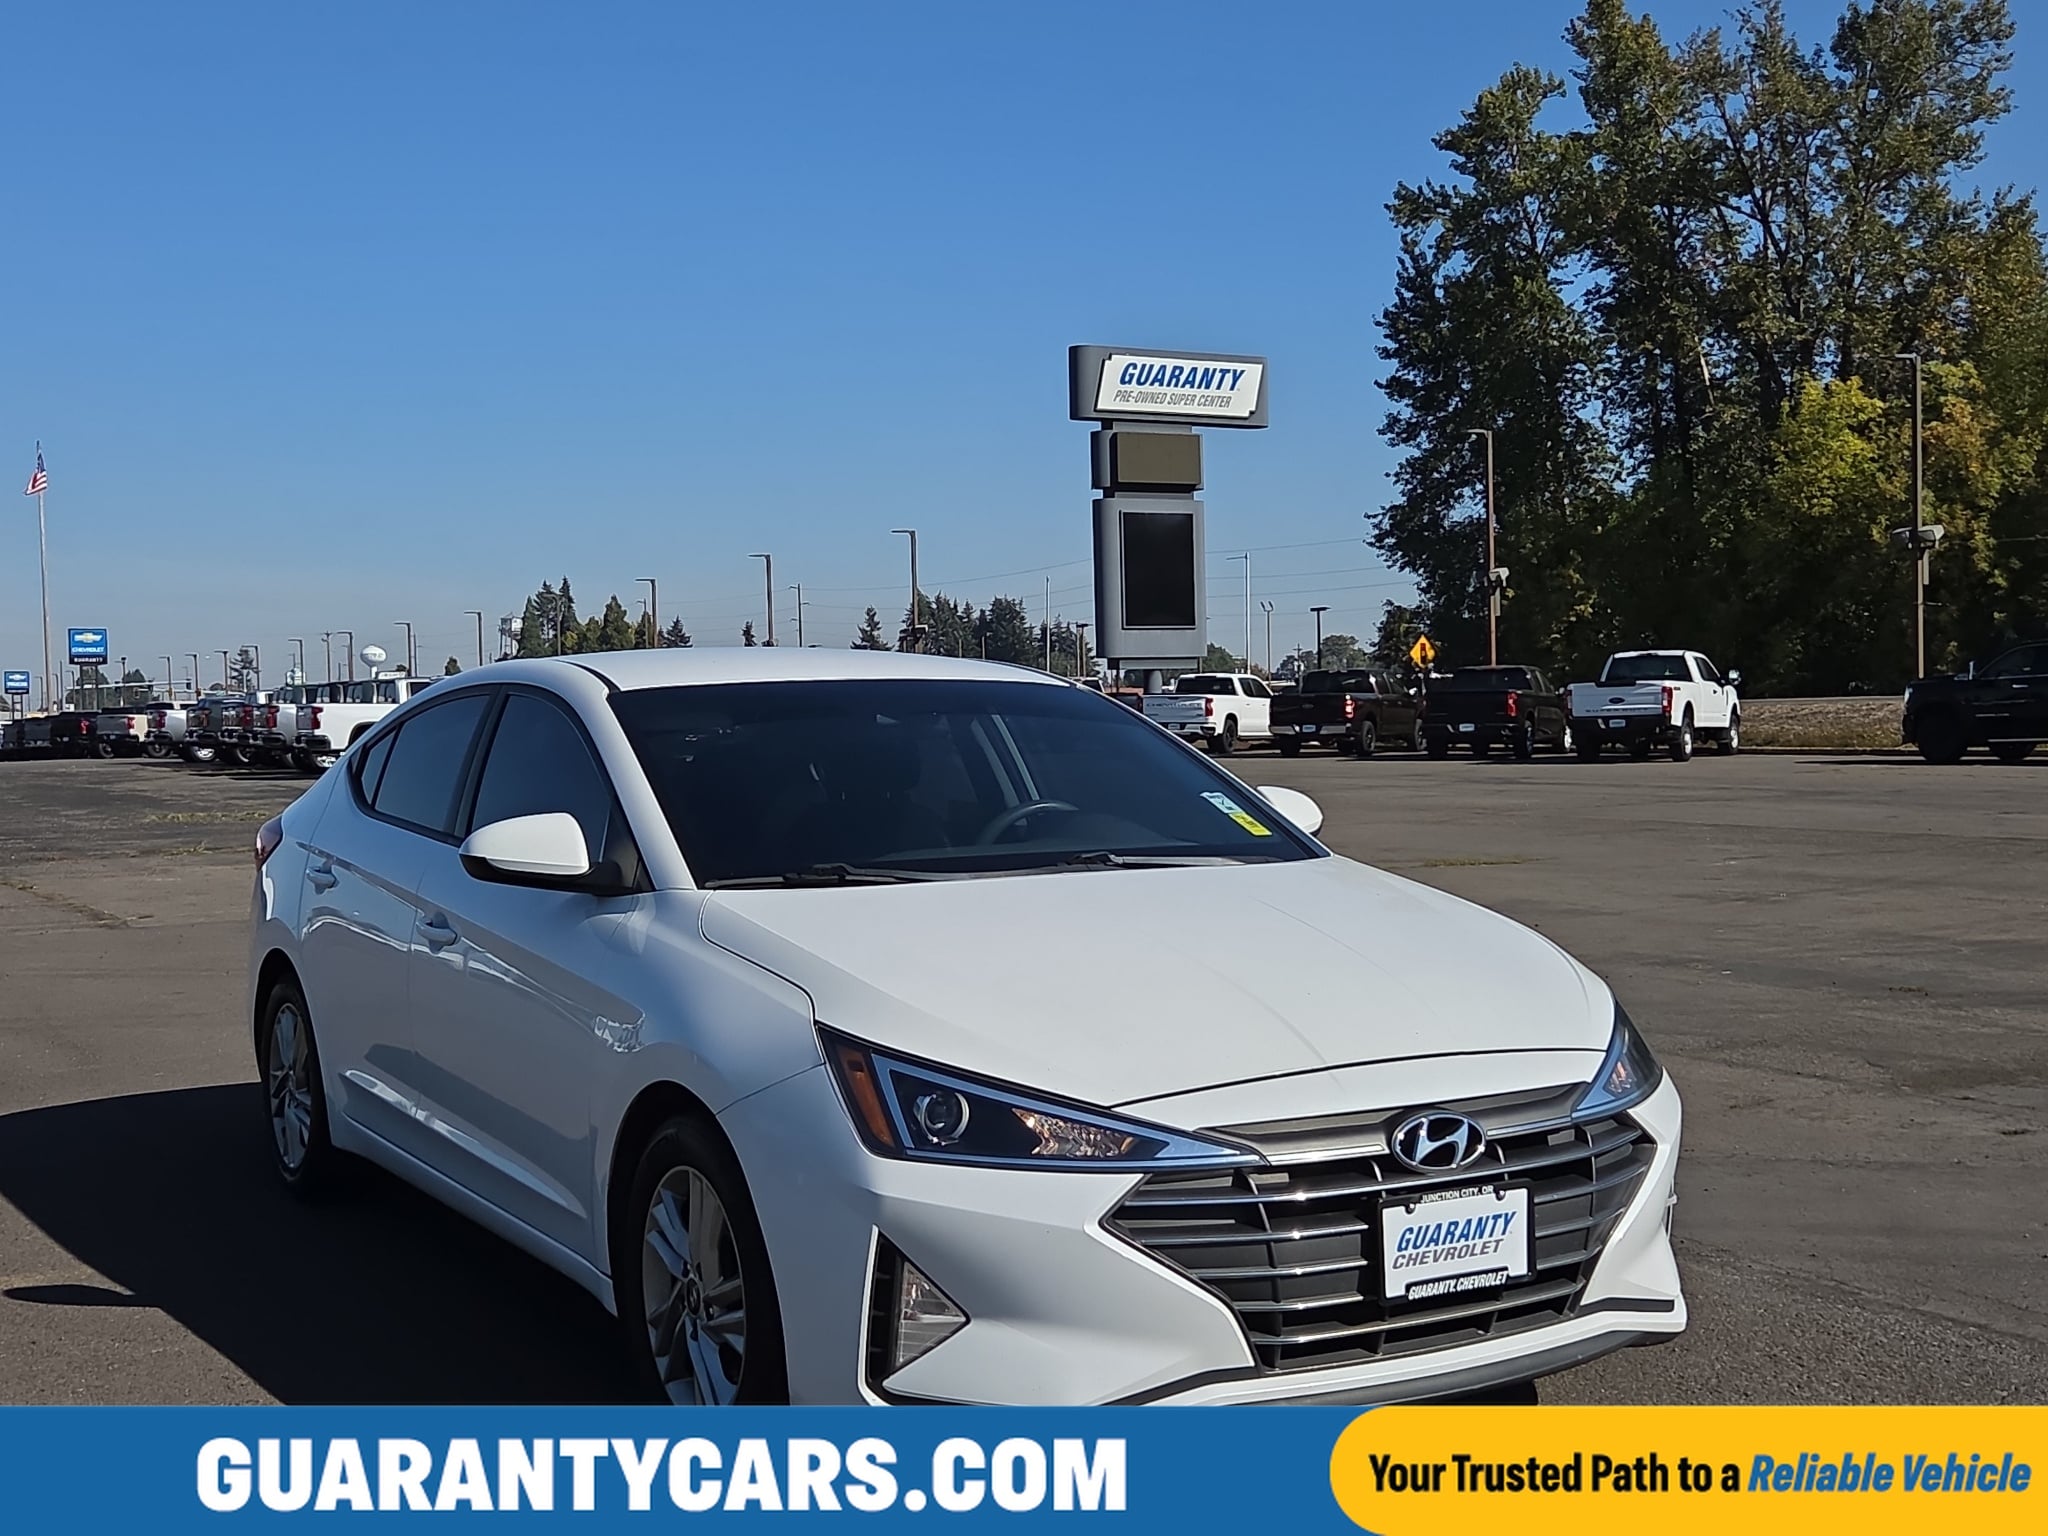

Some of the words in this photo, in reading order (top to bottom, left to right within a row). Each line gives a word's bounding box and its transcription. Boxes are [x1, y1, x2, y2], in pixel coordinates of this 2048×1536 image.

[1119, 362, 1245, 391] GUARANTY
[1113, 389, 1167, 405] PRE-OWNED
[1167, 393, 1197, 406] SUPER
[1197, 395, 1232, 408] CENTER
[1420, 1190, 1460, 1203] JUNCTION
[1482, 1185, 1495, 1195] OR
[1396, 1211, 1517, 1252] GUARANTY
[1392, 1239, 1504, 1269] CHEVROLET
[1456, 1270, 1508, 1292] CHEVROLET
